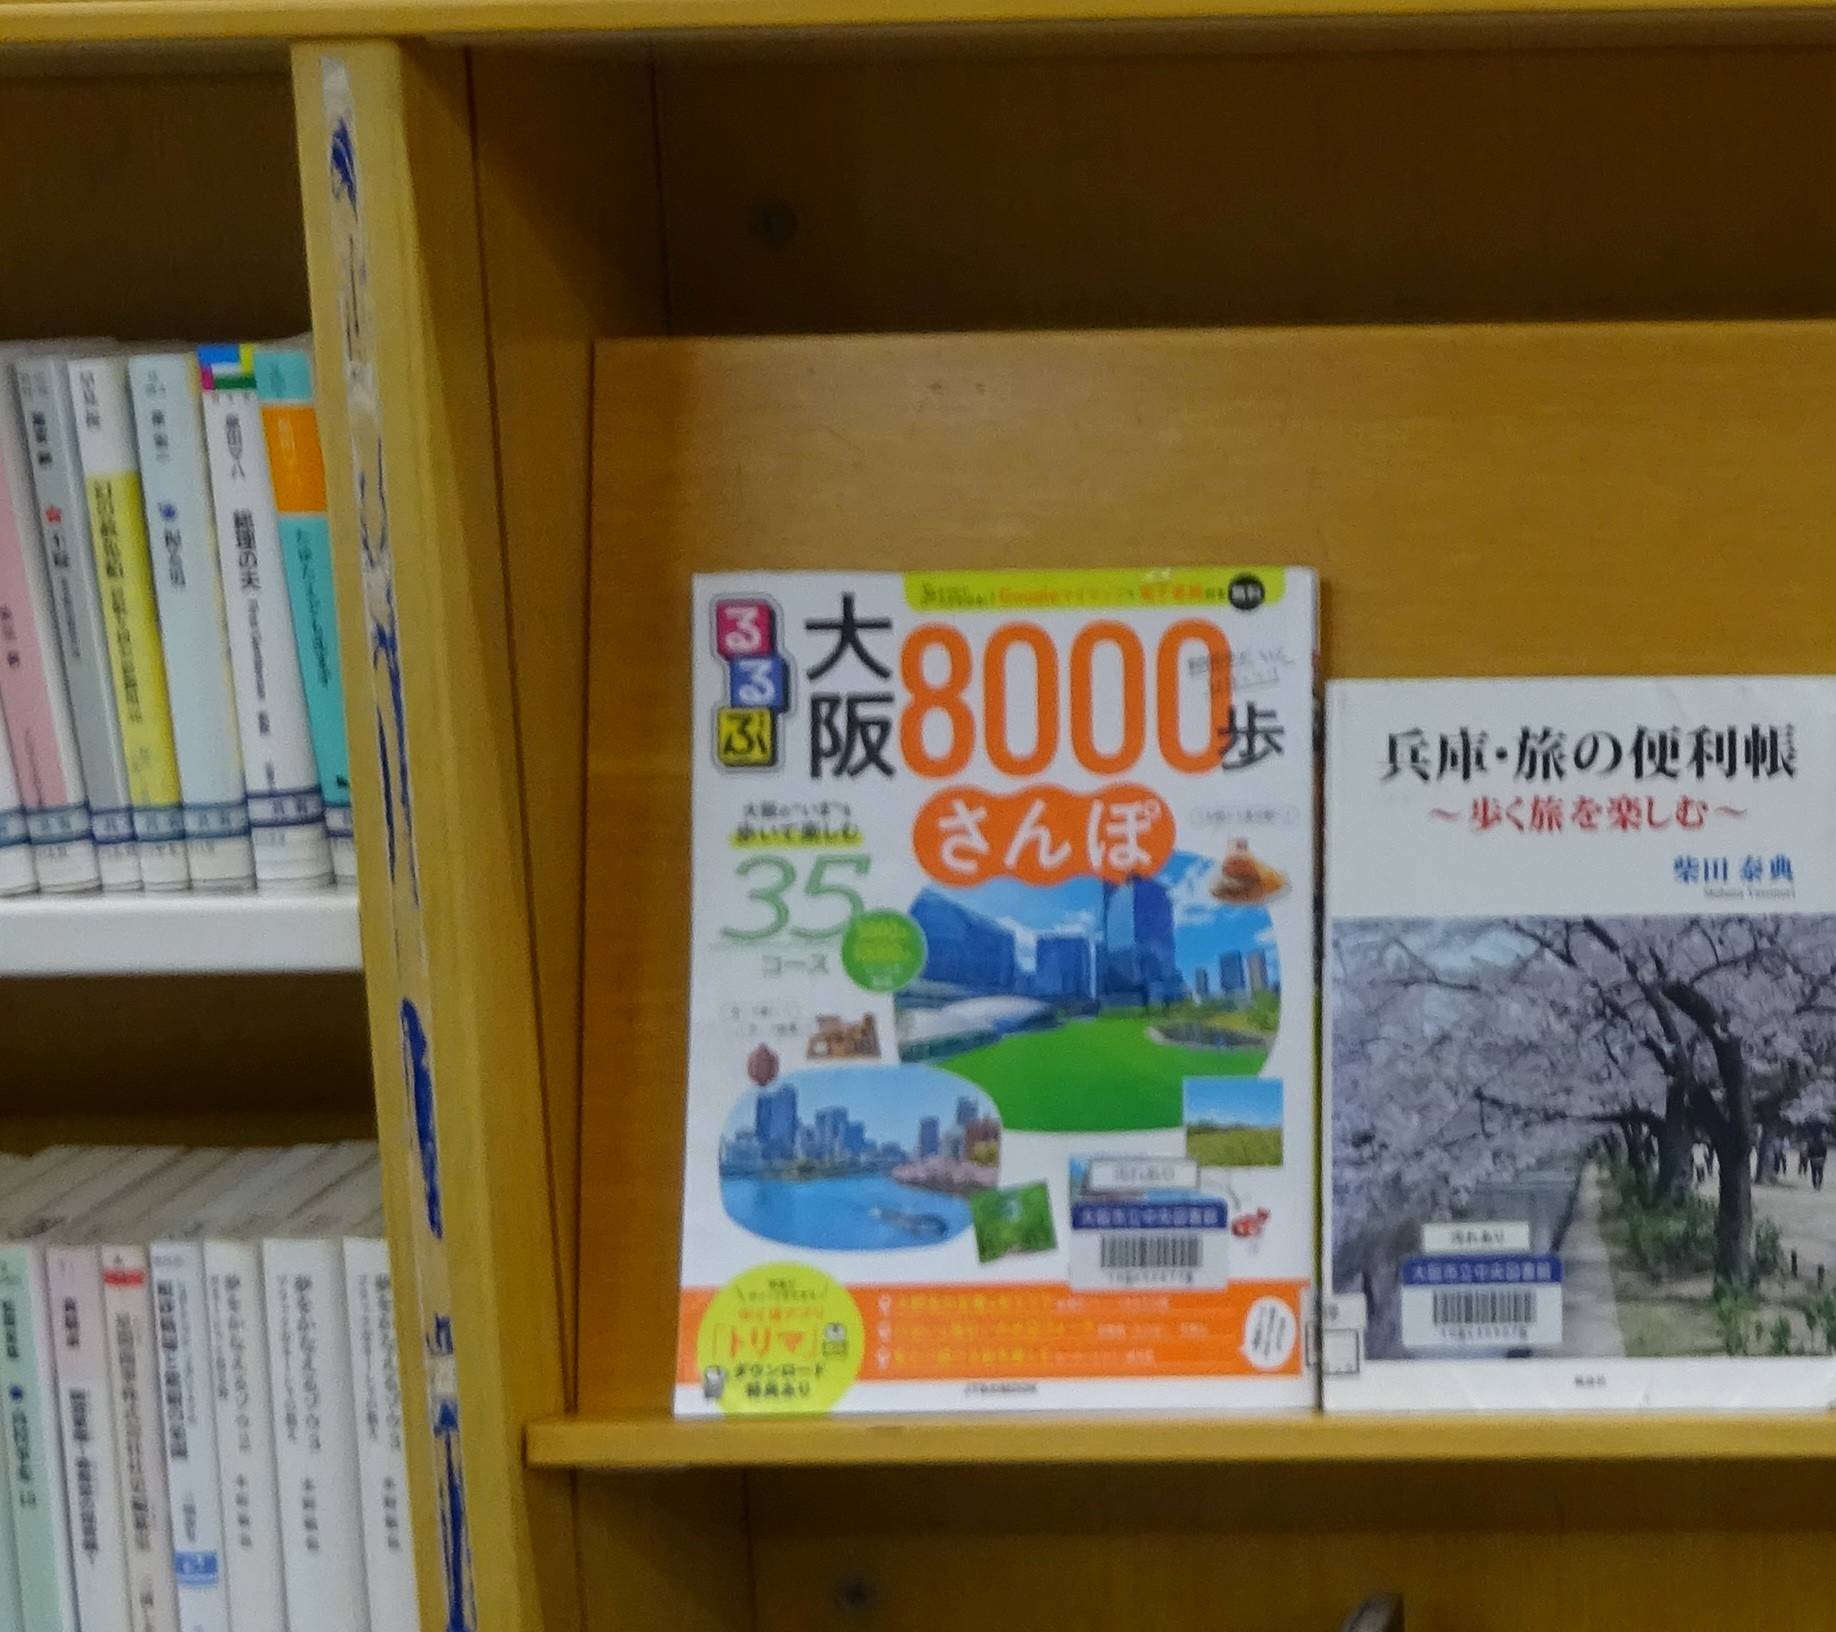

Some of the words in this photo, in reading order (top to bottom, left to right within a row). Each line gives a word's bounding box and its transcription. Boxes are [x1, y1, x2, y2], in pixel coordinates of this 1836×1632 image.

[805, 591, 896, 779] 大阪
[1380, 723, 1799, 784] 兵庫・旅の便利帳
[936, 788, 1157, 869] さんぽ
[719, 852, 872, 941] 35
